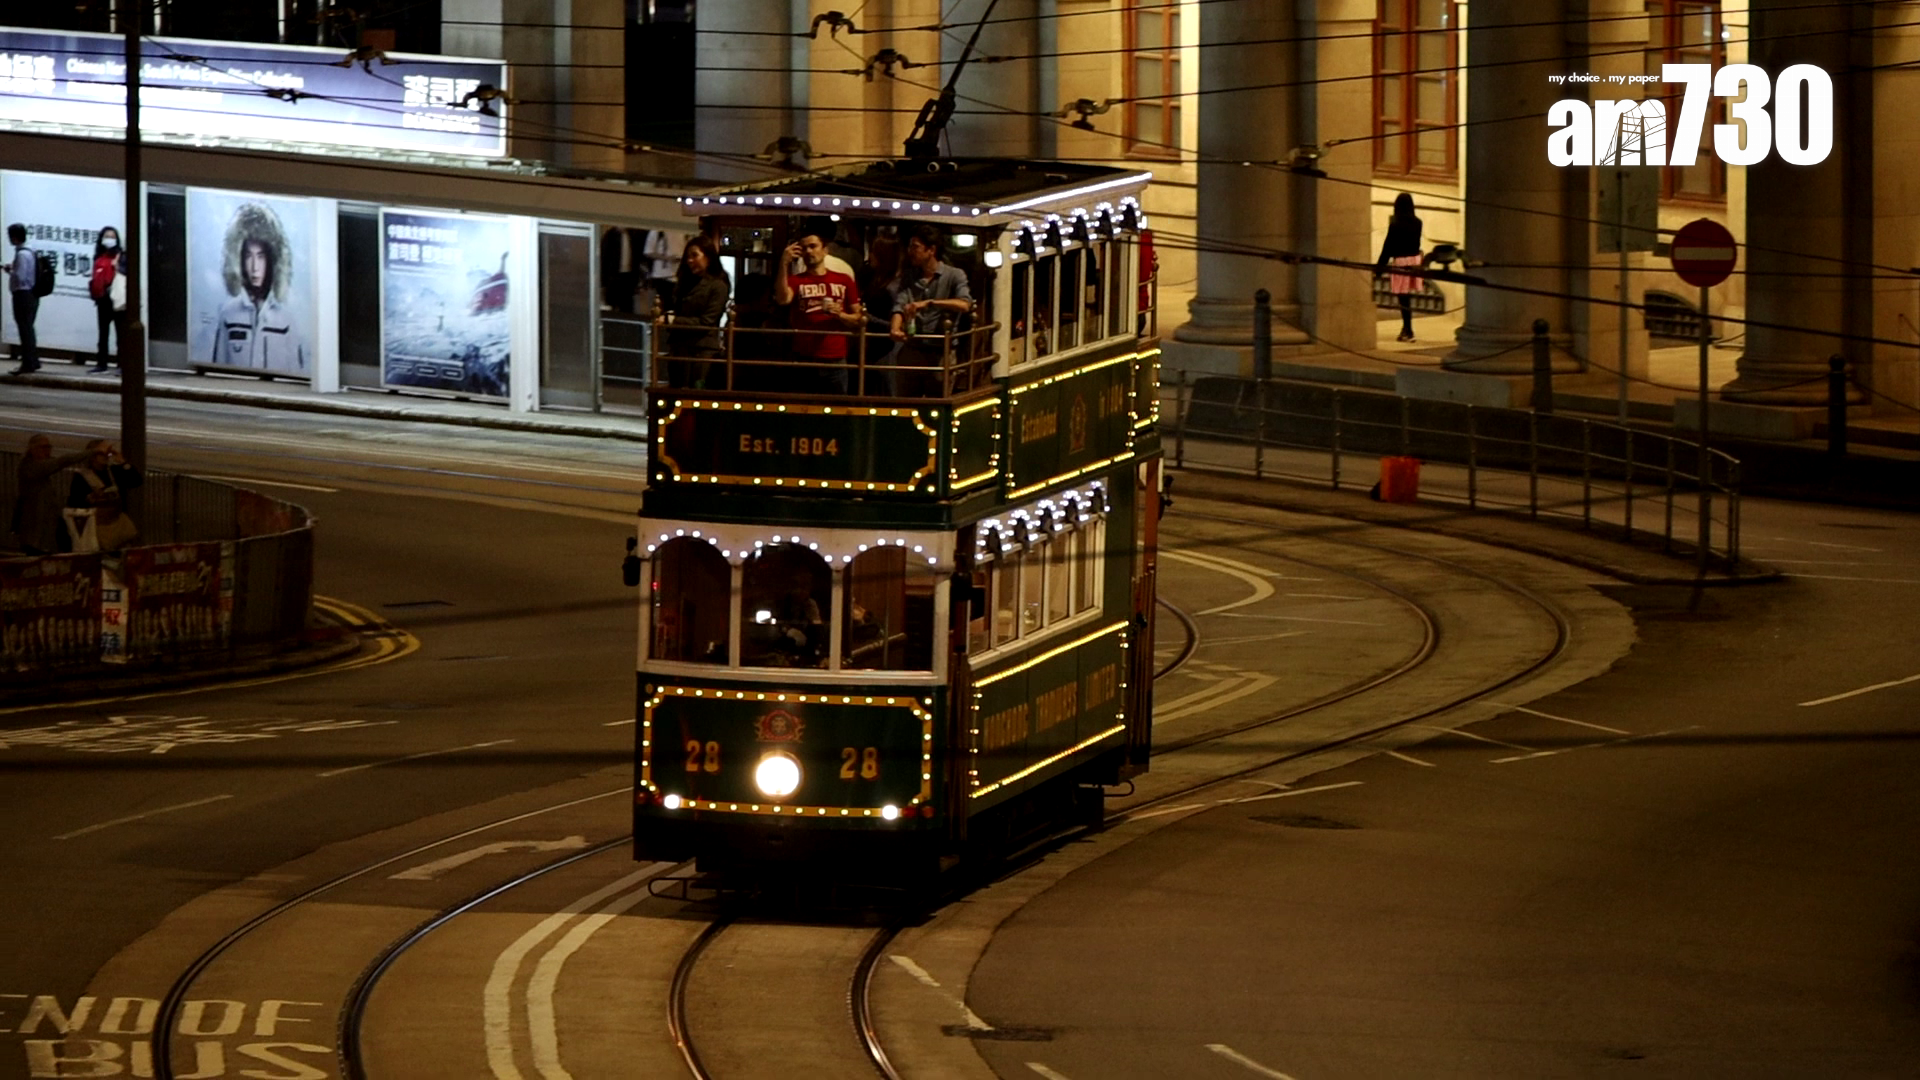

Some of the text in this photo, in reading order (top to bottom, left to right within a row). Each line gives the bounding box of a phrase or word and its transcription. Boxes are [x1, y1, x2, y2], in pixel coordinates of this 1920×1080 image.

[106, 61, 126, 76] Nor
[739, 434, 838, 457] Est. 1904
[685, 740, 721, 772] 28
[839, 746, 879, 779] 28
[178, 999, 323, 1036] OF
[24, 1039, 333, 1080] BUS
